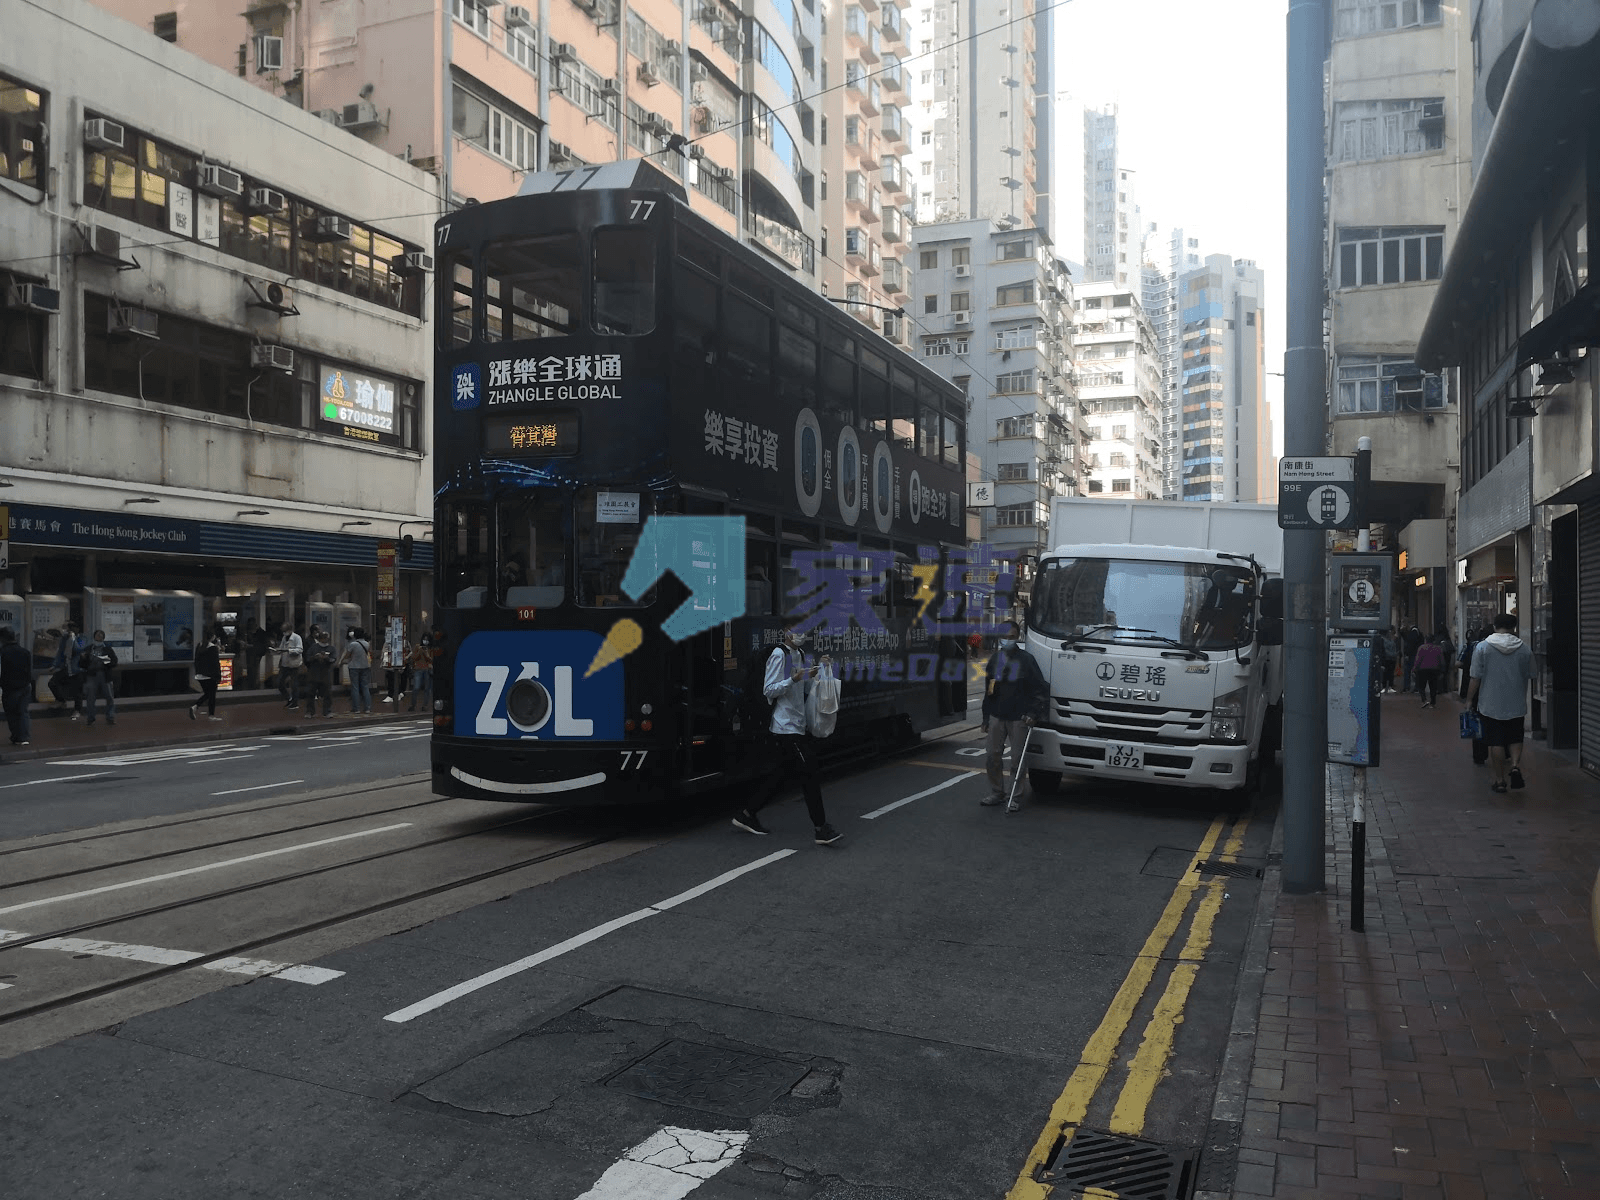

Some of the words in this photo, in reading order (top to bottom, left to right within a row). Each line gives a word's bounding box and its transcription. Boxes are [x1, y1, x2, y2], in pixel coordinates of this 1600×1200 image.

[552, 166, 602, 192] 77
[629, 199, 656, 220] 77
[437, 224, 451, 246] 77
[488, 354, 622, 387] 漲樂全球通
[355, 380, 394, 414] 瑜伽
[488, 386, 554, 405] ZHANGLE
[558, 384, 622, 401] GLOBAL
[510, 423, 557, 448] 筲箕灣
[704, 408, 778, 472] 樂享投資
[1284, 461, 1315, 470] 南康街
[975, 486, 989, 501] 德
[1284, 485, 1303, 494] 99E
[72, 522, 90, 535] The
[91, 524, 115, 538] Hong
[116, 526, 138, 541] Kong
[138, 528, 166, 543] Jockey
[168, 530, 187, 542] Club
[518, 609, 534, 619] 101
[1120, 664, 1166, 686] 碧瑤
[1099, 685, 1161, 702] ISUZU
[619, 750, 648, 771] 77
[1115, 745, 1135, 756] XJ
[1108, 755, 1140, 768] 1872
